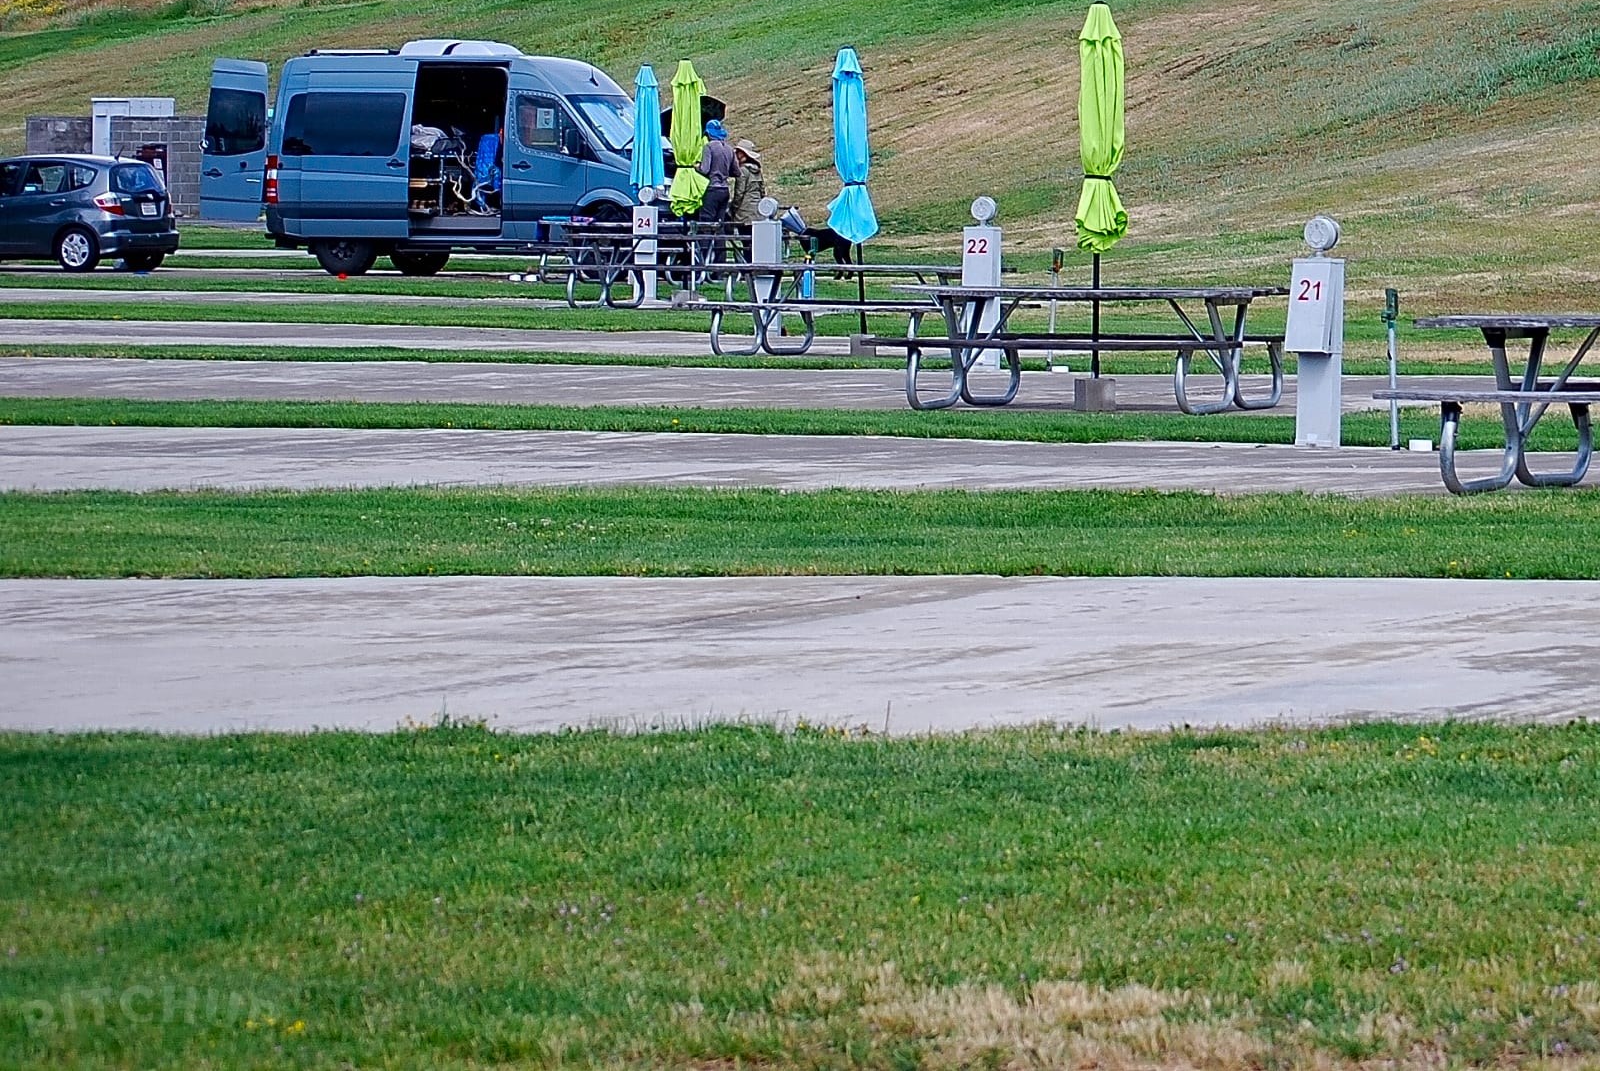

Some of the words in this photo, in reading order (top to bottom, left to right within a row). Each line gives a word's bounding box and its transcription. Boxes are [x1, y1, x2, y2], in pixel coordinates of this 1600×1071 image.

[637, 217, 651, 228] 24
[967, 238, 988, 254] 22
[1297, 279, 1321, 301] 21
